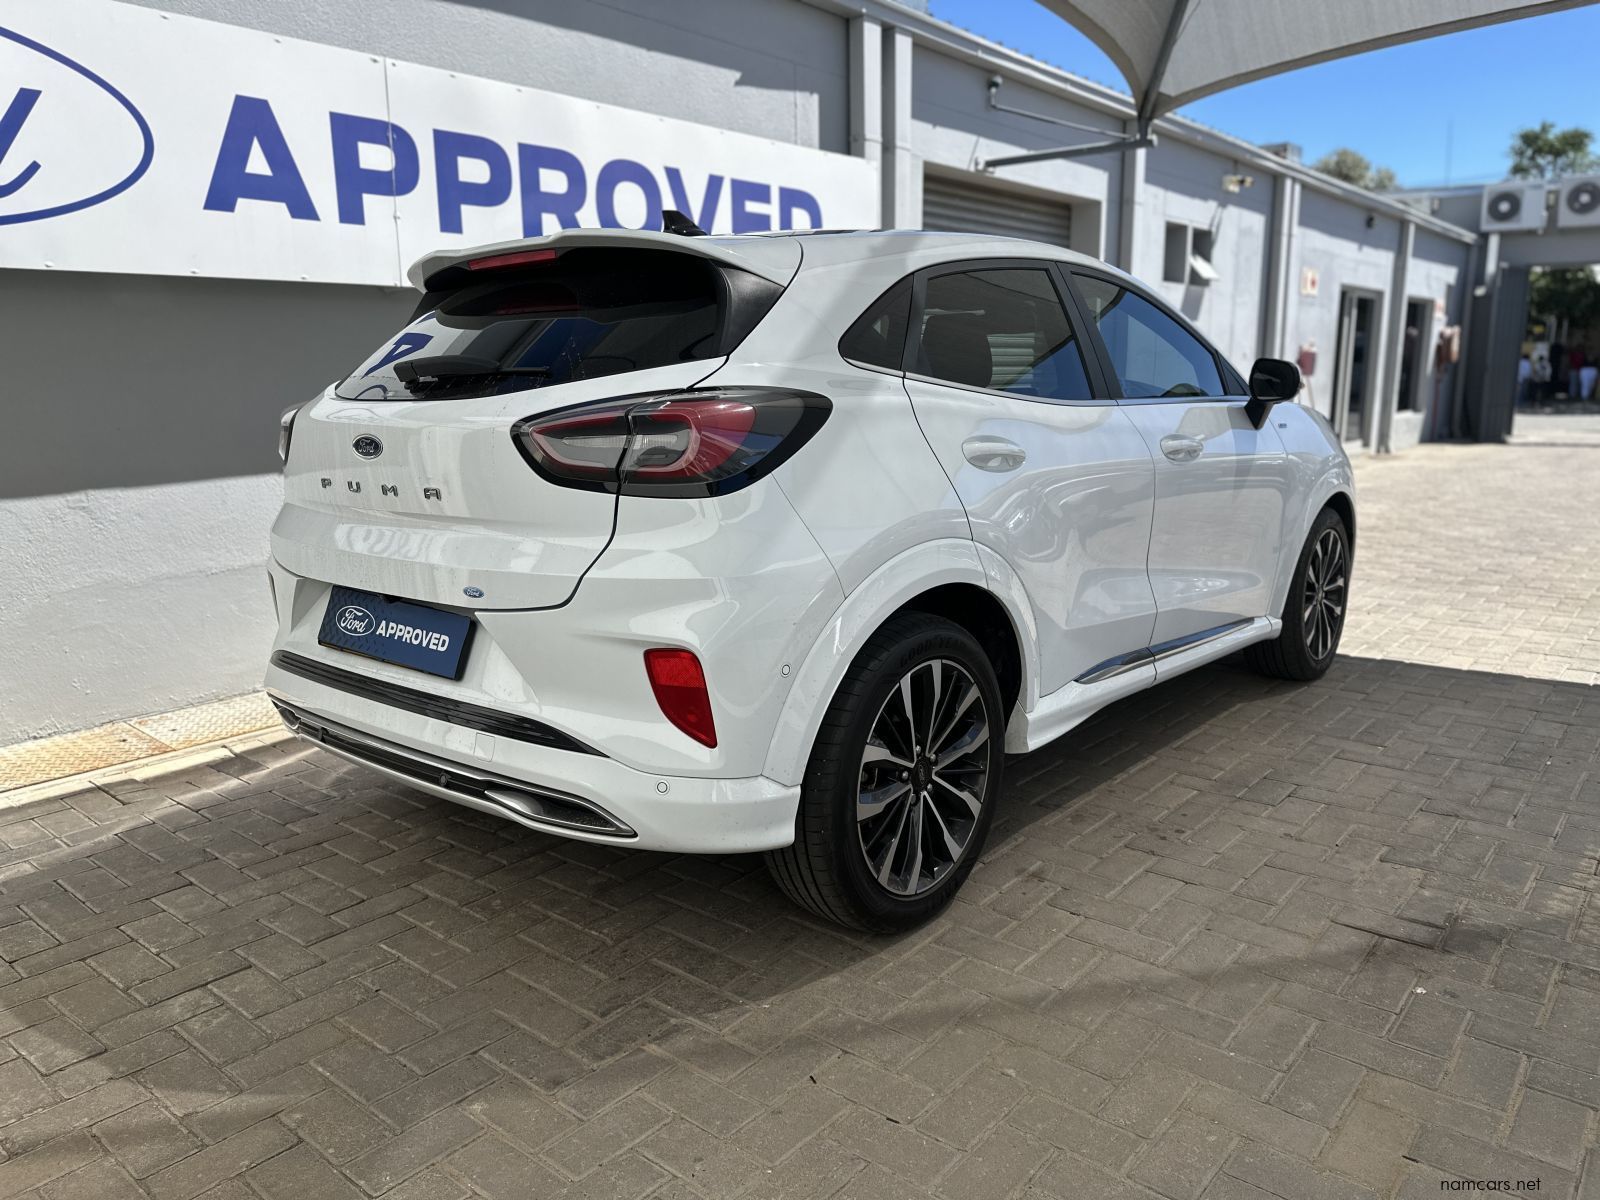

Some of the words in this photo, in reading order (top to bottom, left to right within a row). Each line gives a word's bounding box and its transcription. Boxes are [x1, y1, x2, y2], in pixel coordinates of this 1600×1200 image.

[203, 93, 823, 236] APPROVED
[320, 477, 442, 501] PUMA
[340, 608, 369, 632] Ford
[375, 620, 450, 652] APPROVED
